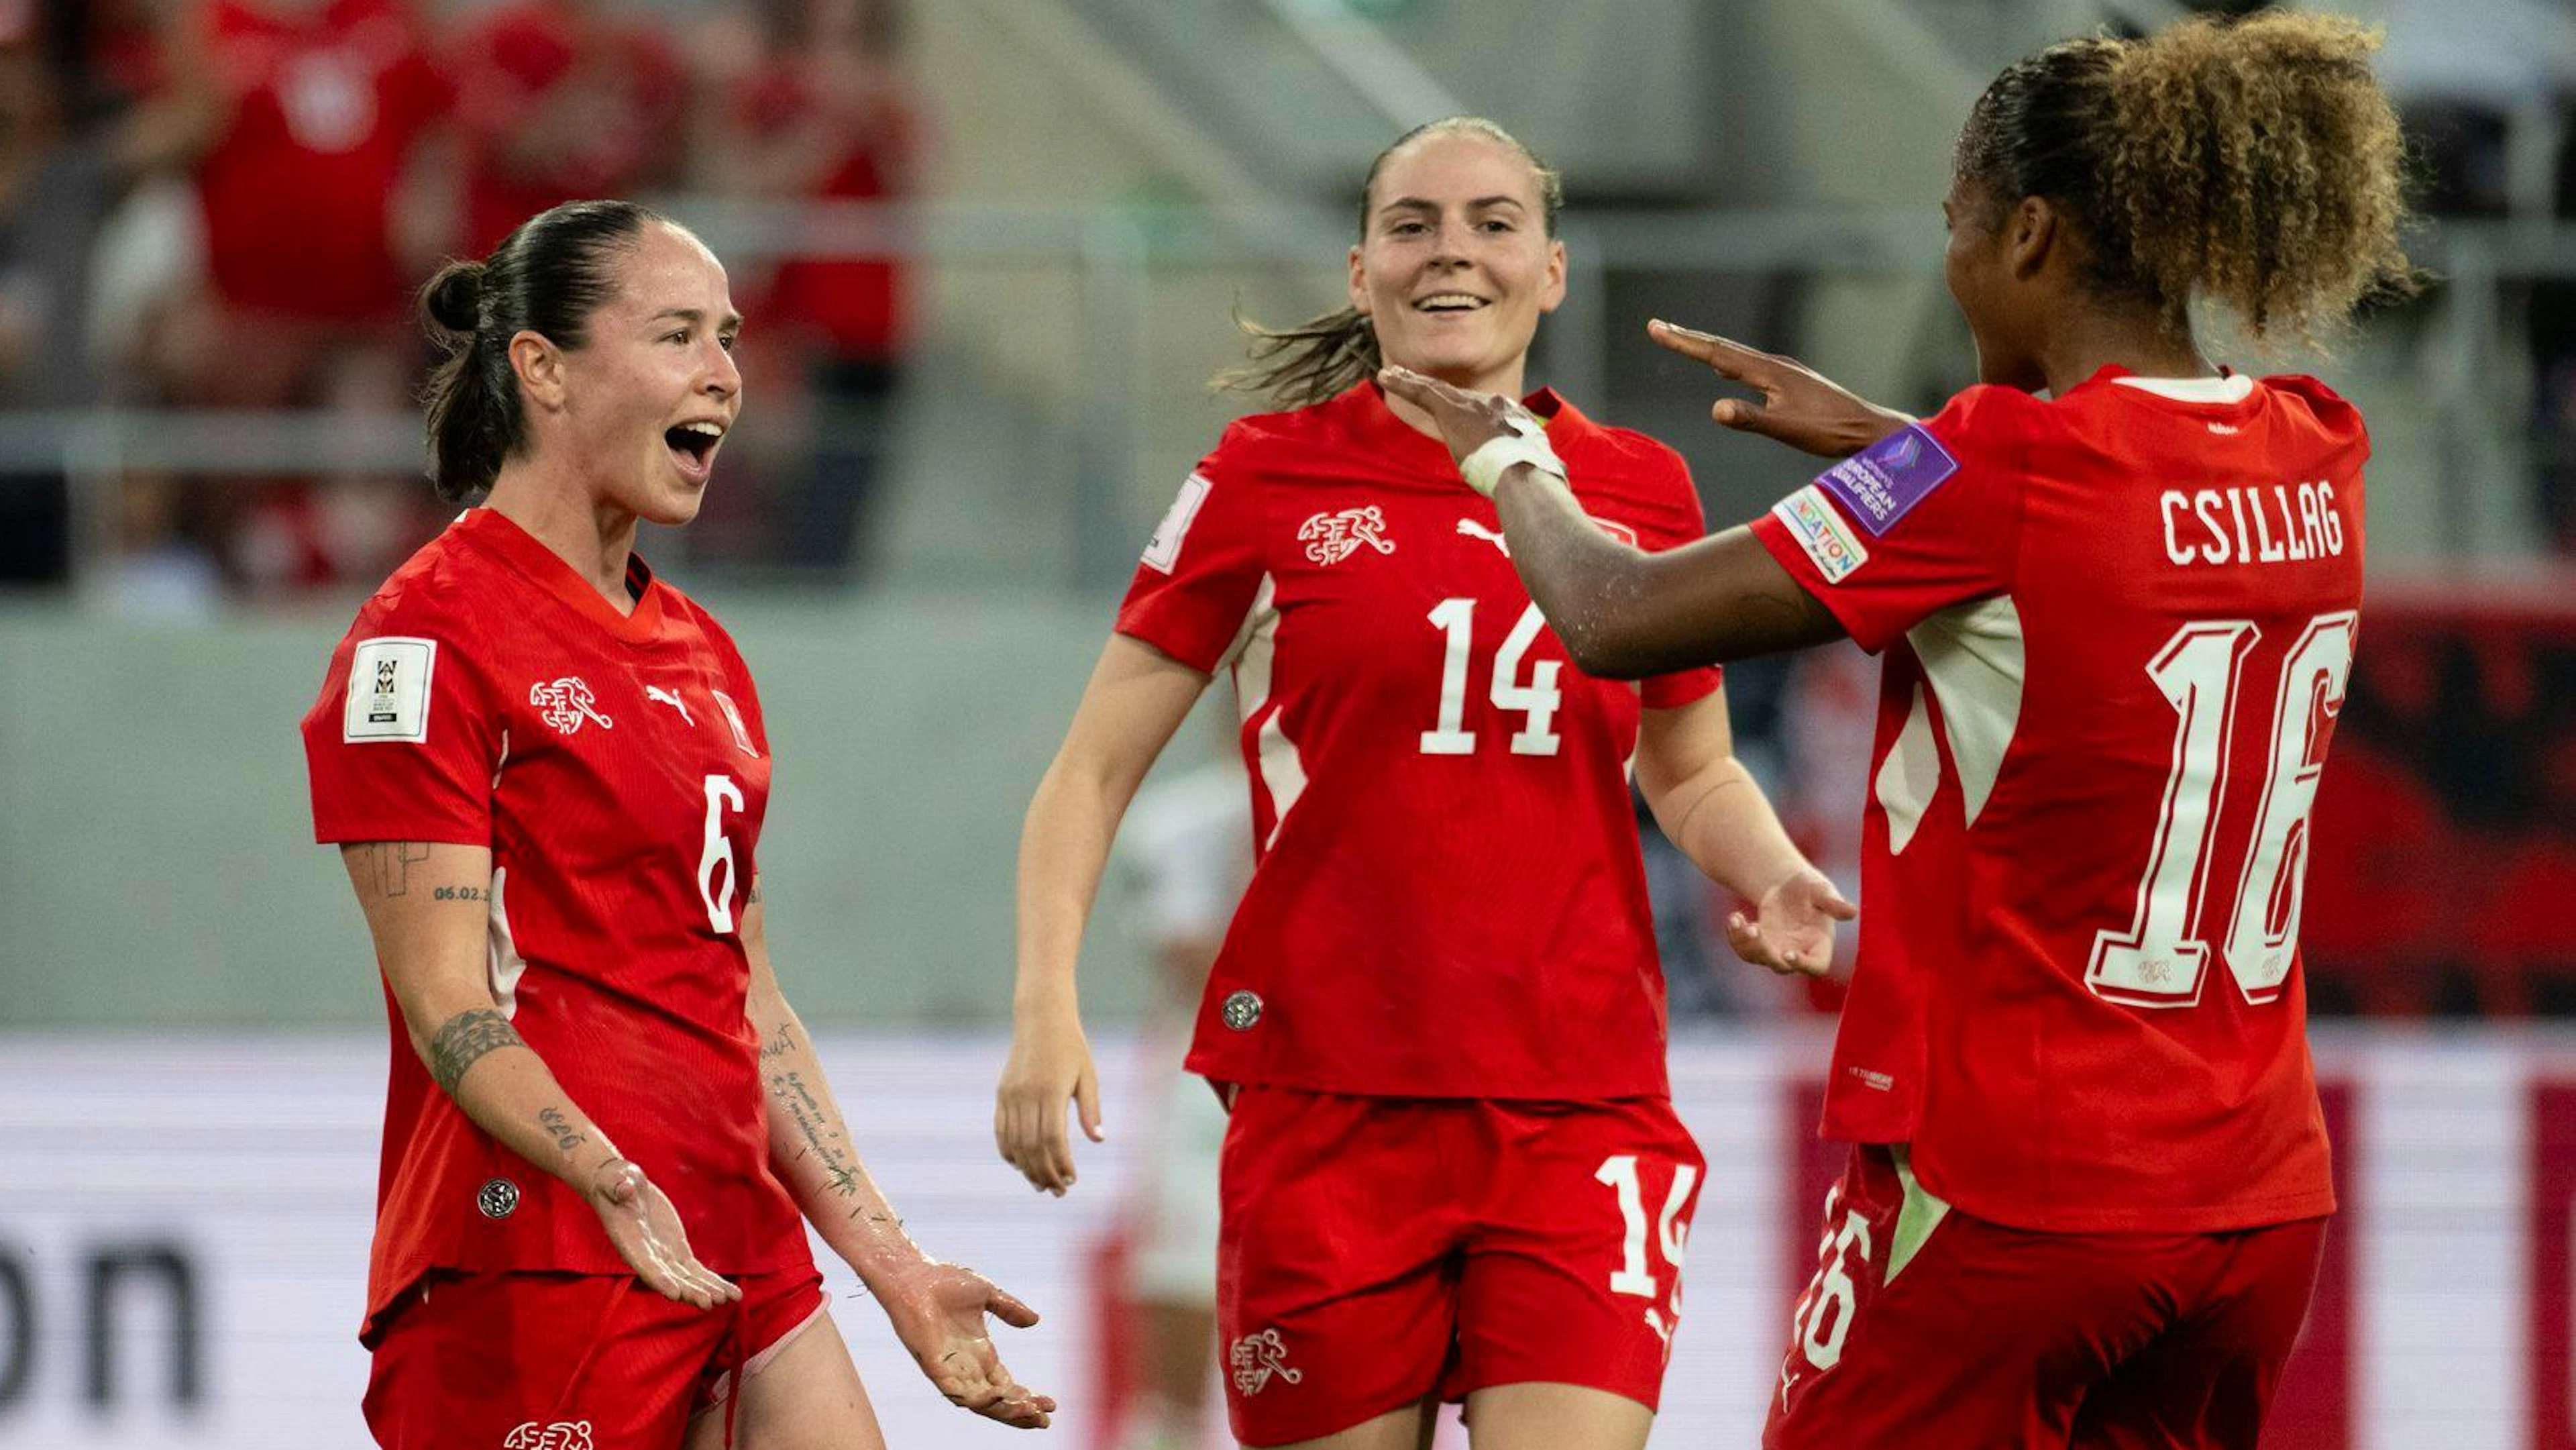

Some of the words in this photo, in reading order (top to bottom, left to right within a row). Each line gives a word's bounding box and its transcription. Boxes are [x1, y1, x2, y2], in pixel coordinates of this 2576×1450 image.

[2161, 480, 2343, 566] CSILLAG
[1419, 598, 1563, 756] 14
[698, 775, 744, 933] 6
[2084, 610, 2359, 1008] 16
